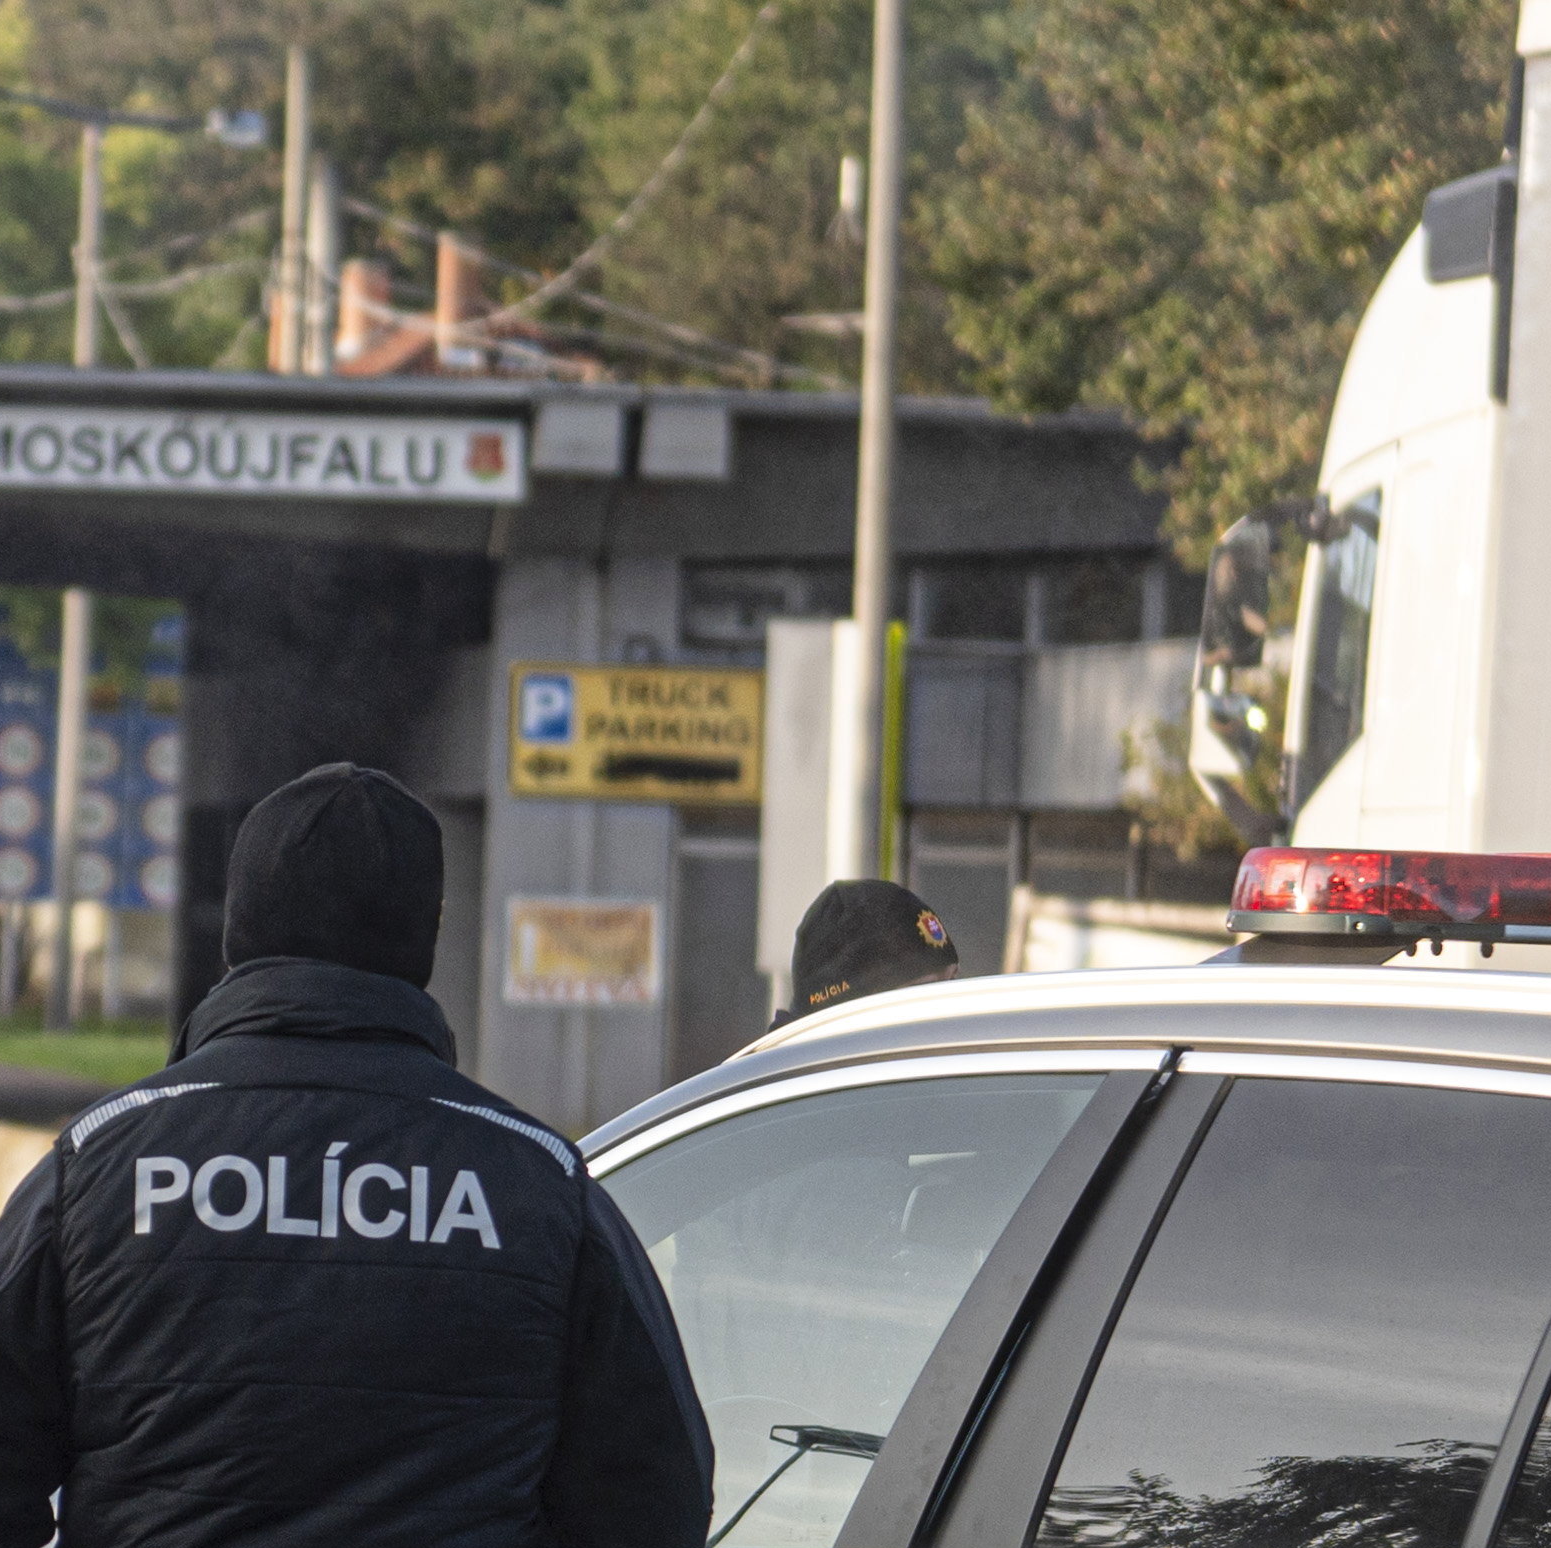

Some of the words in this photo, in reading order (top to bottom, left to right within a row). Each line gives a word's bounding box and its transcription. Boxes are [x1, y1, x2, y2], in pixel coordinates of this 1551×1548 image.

[607, 675, 729, 708] TRUCK
[585, 712, 750, 745] PARKING
[809, 980, 850, 1005] POLÍCIA
[134, 1141, 502, 1250] POLÍCIA
